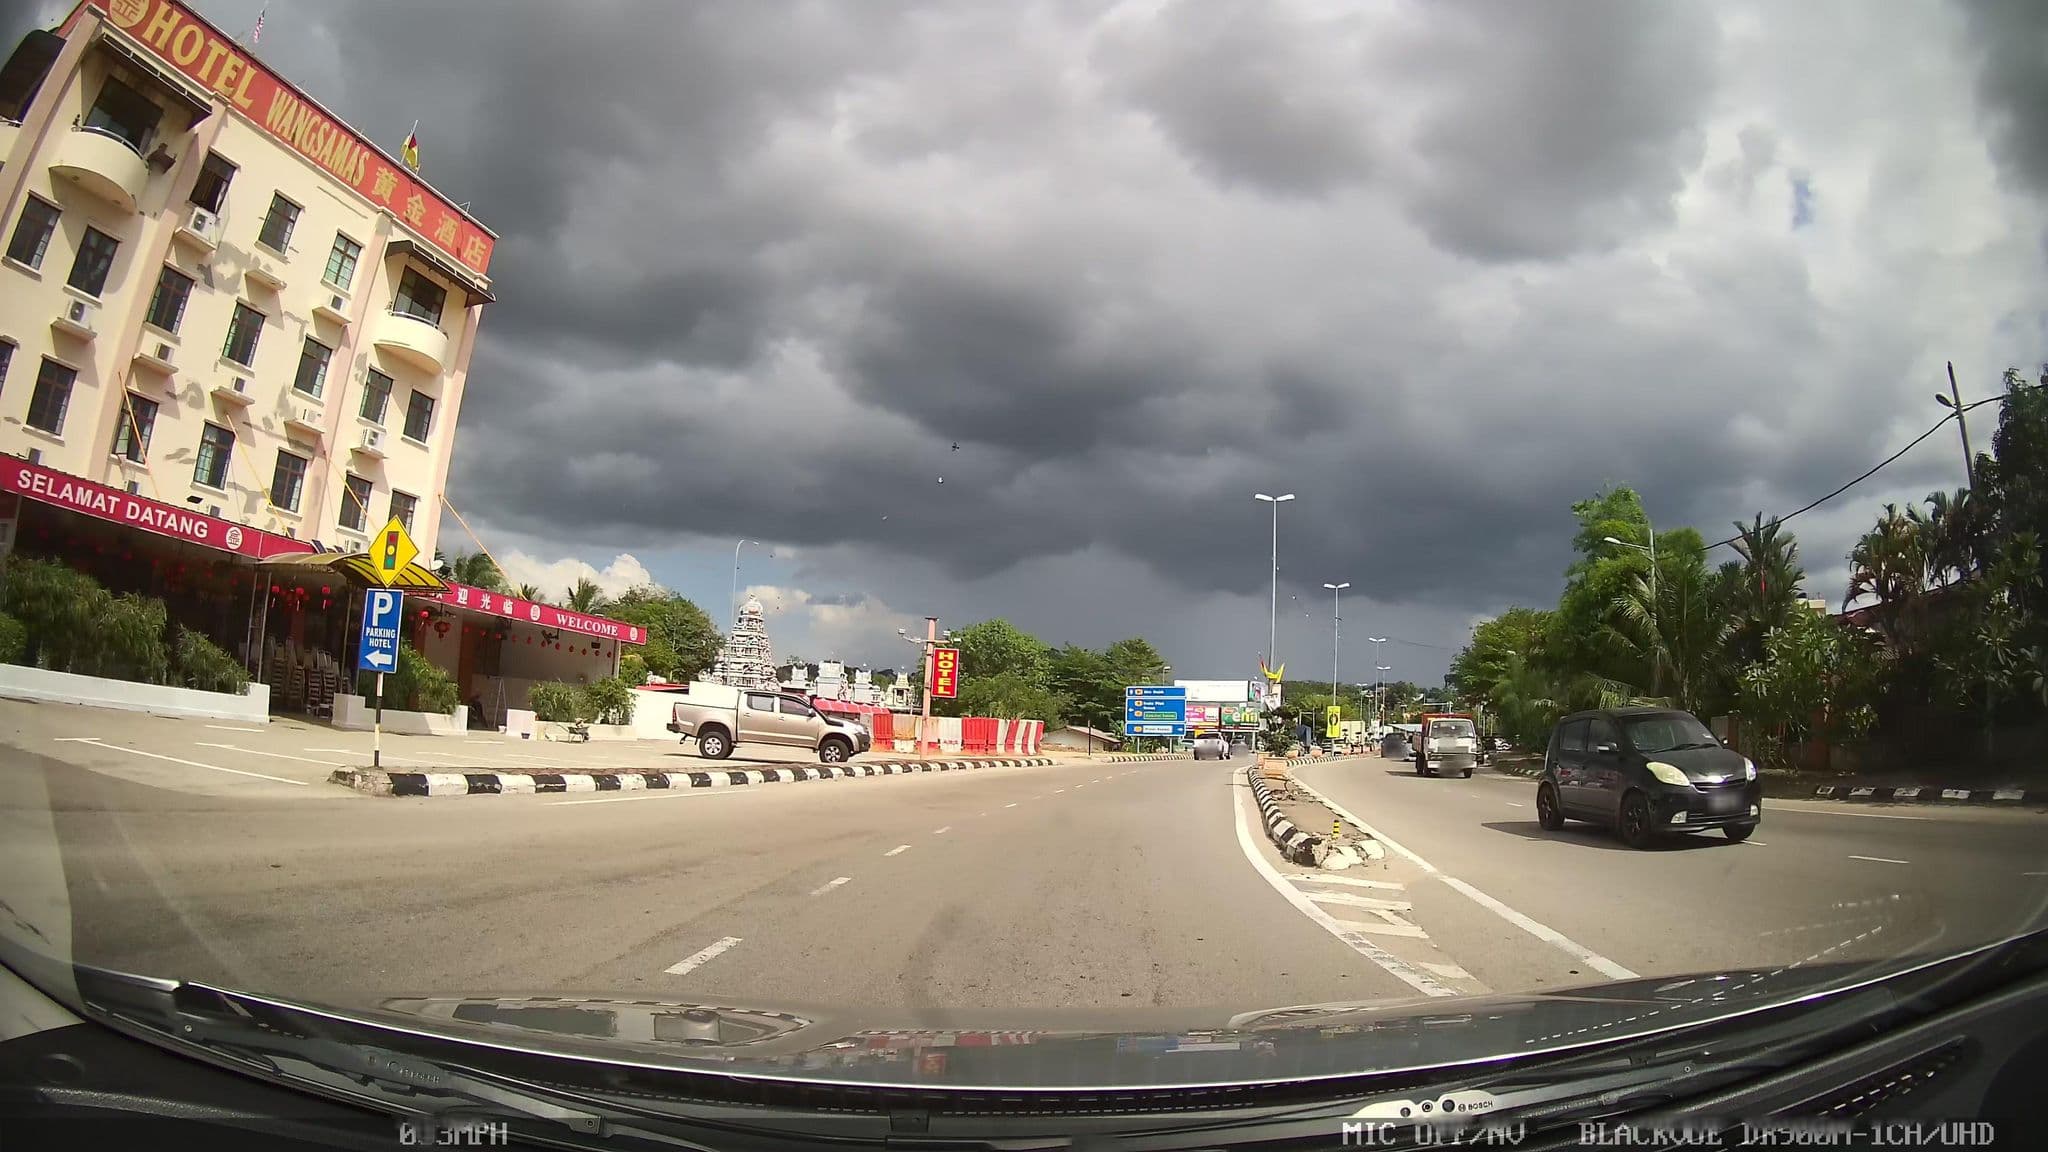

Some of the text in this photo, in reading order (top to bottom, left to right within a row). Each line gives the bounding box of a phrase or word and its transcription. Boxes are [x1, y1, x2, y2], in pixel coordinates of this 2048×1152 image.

[142, 0, 370, 187] HOTEL WANGSAMAS
[17, 469, 208, 539] SELAMAT DATANG
[372, 592, 393, 627] P
[365, 627, 396, 639] PARKING
[556, 613, 618, 637] WELCOME
[369, 638, 391, 648] HOTEL
[937, 651, 954, 694] HOTEL
[1468, 1100, 1493, 1110] BOSCH
